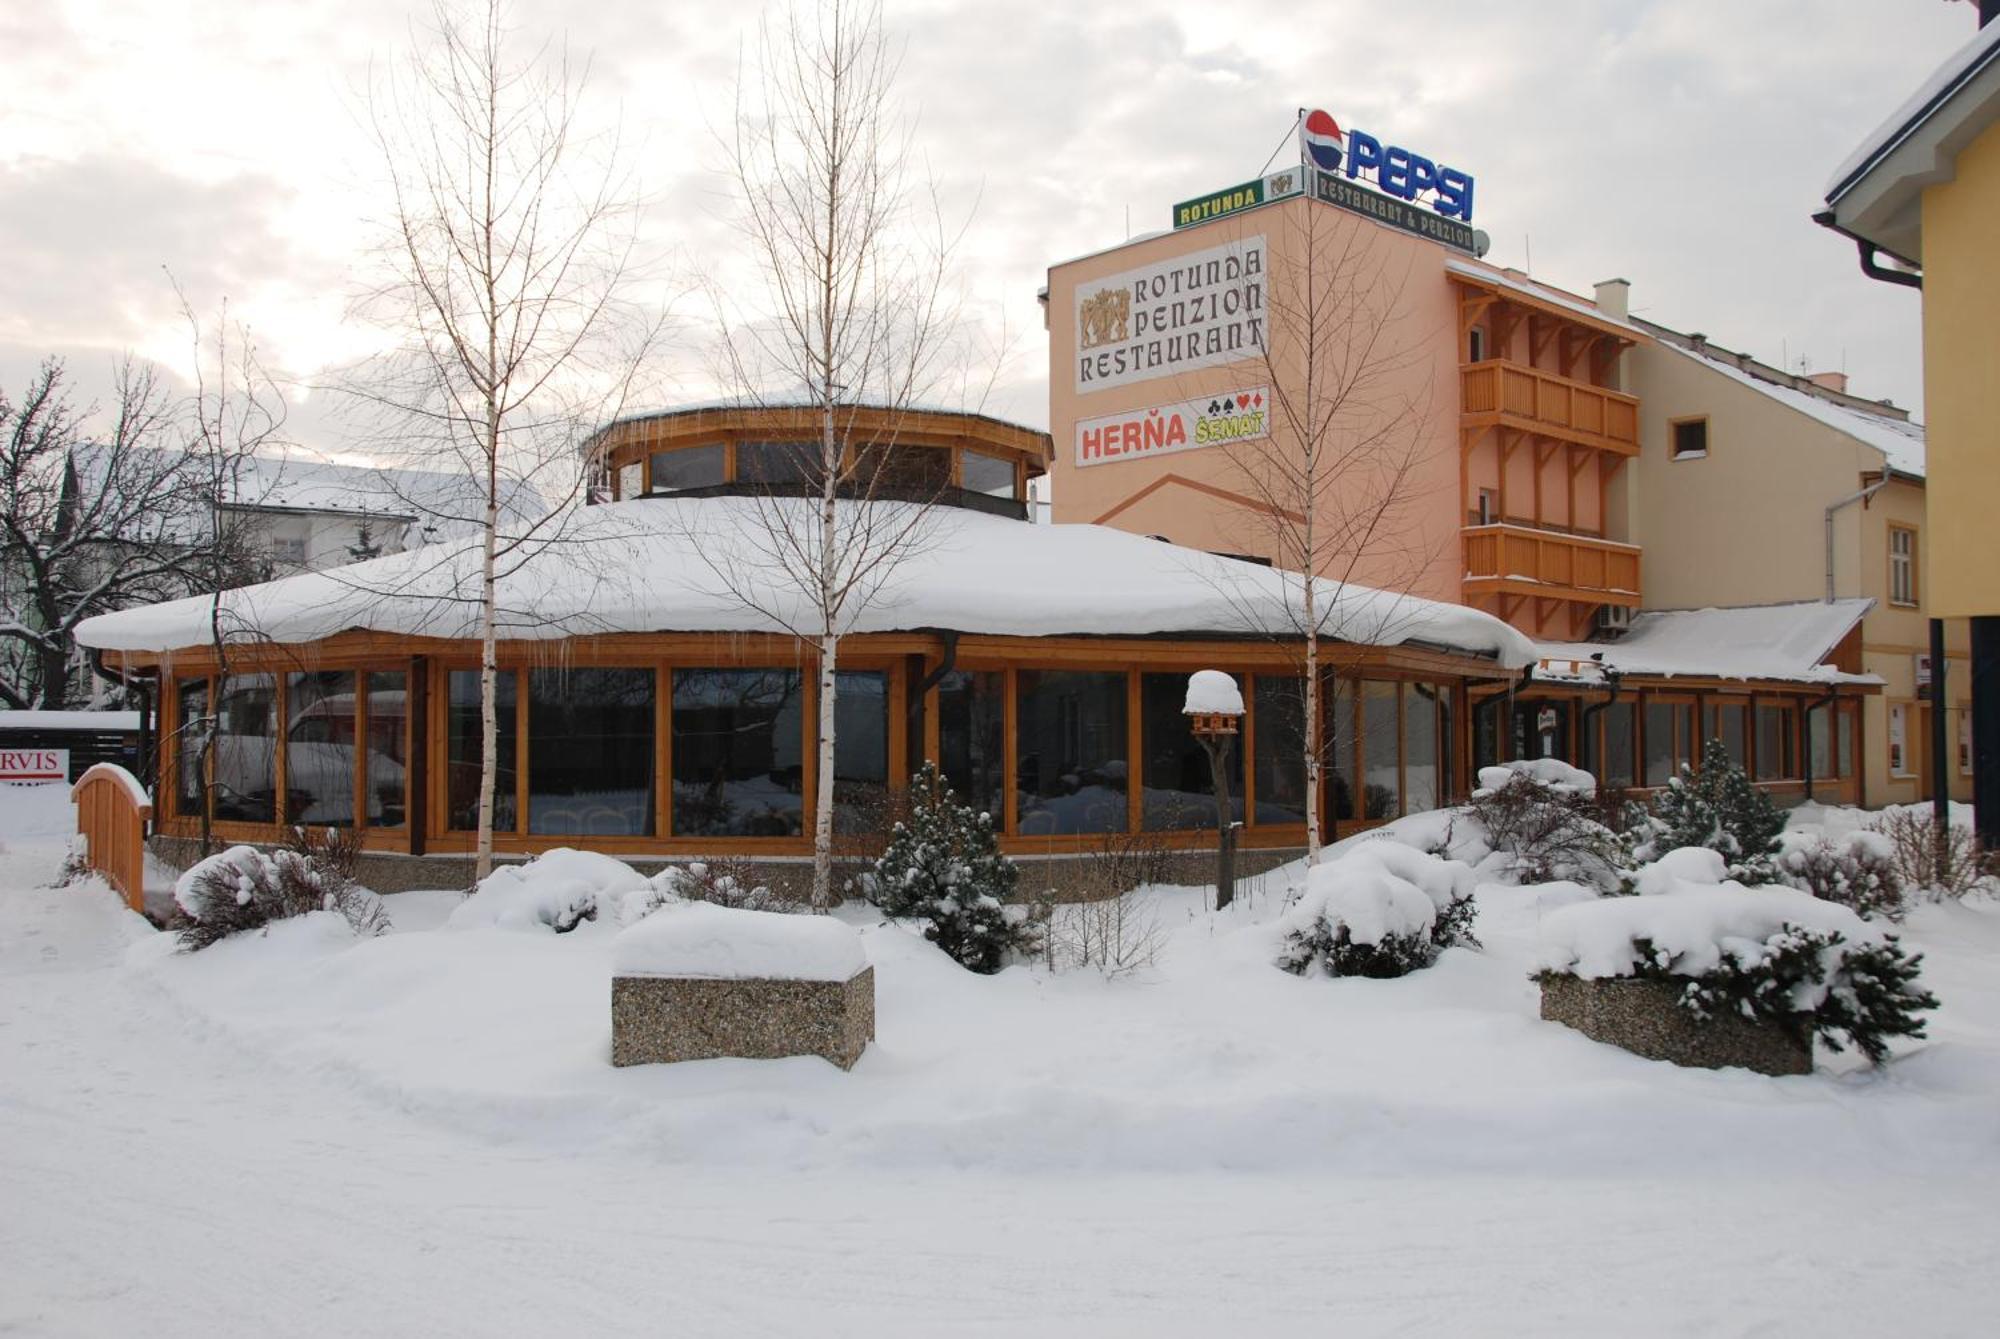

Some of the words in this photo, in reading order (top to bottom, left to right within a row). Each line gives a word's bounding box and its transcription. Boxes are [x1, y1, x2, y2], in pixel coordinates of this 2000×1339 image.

[1346, 129, 1474, 222] PEPSI
[1180, 189, 1256, 225] ROTUNDA
[1407, 212, 1416, 228] &
[1135, 249, 1262, 304] ROTUNDA
[1135, 283, 1262, 338] PENZION
[1080, 318, 1263, 383] RESTAURANT
[1082, 408, 1187, 460] HERŇA
